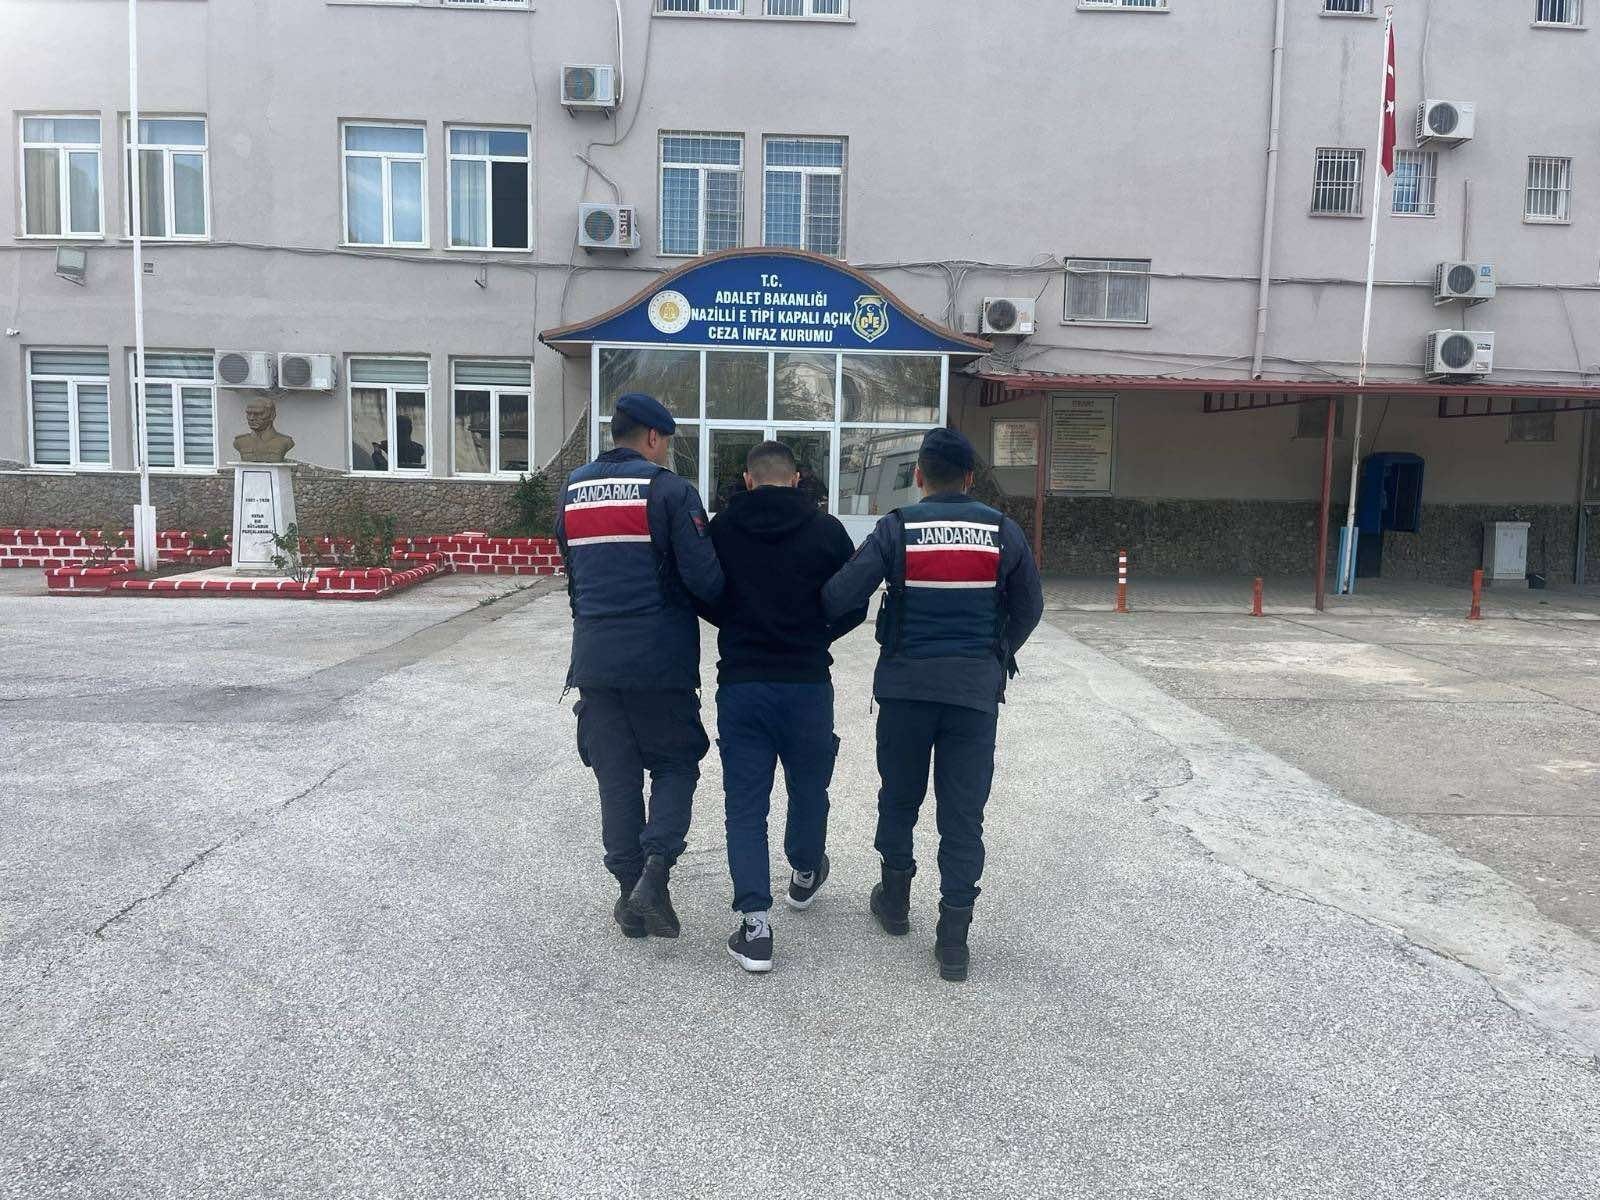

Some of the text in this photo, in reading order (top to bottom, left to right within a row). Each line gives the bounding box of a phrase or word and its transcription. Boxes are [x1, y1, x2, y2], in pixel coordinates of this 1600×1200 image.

[761, 274, 783, 288] T.C.
[715, 290, 828, 307] ADALET BAKANLIĞI
[691, 307, 852, 329] NAZİLLİ E TİPİ KAPALI AÇIK
[708, 325, 833, 343] CEZA İNFAZ KURUMU
[573, 484, 641, 504] JANDARMA
[917, 527, 994, 547] JANDARMA
